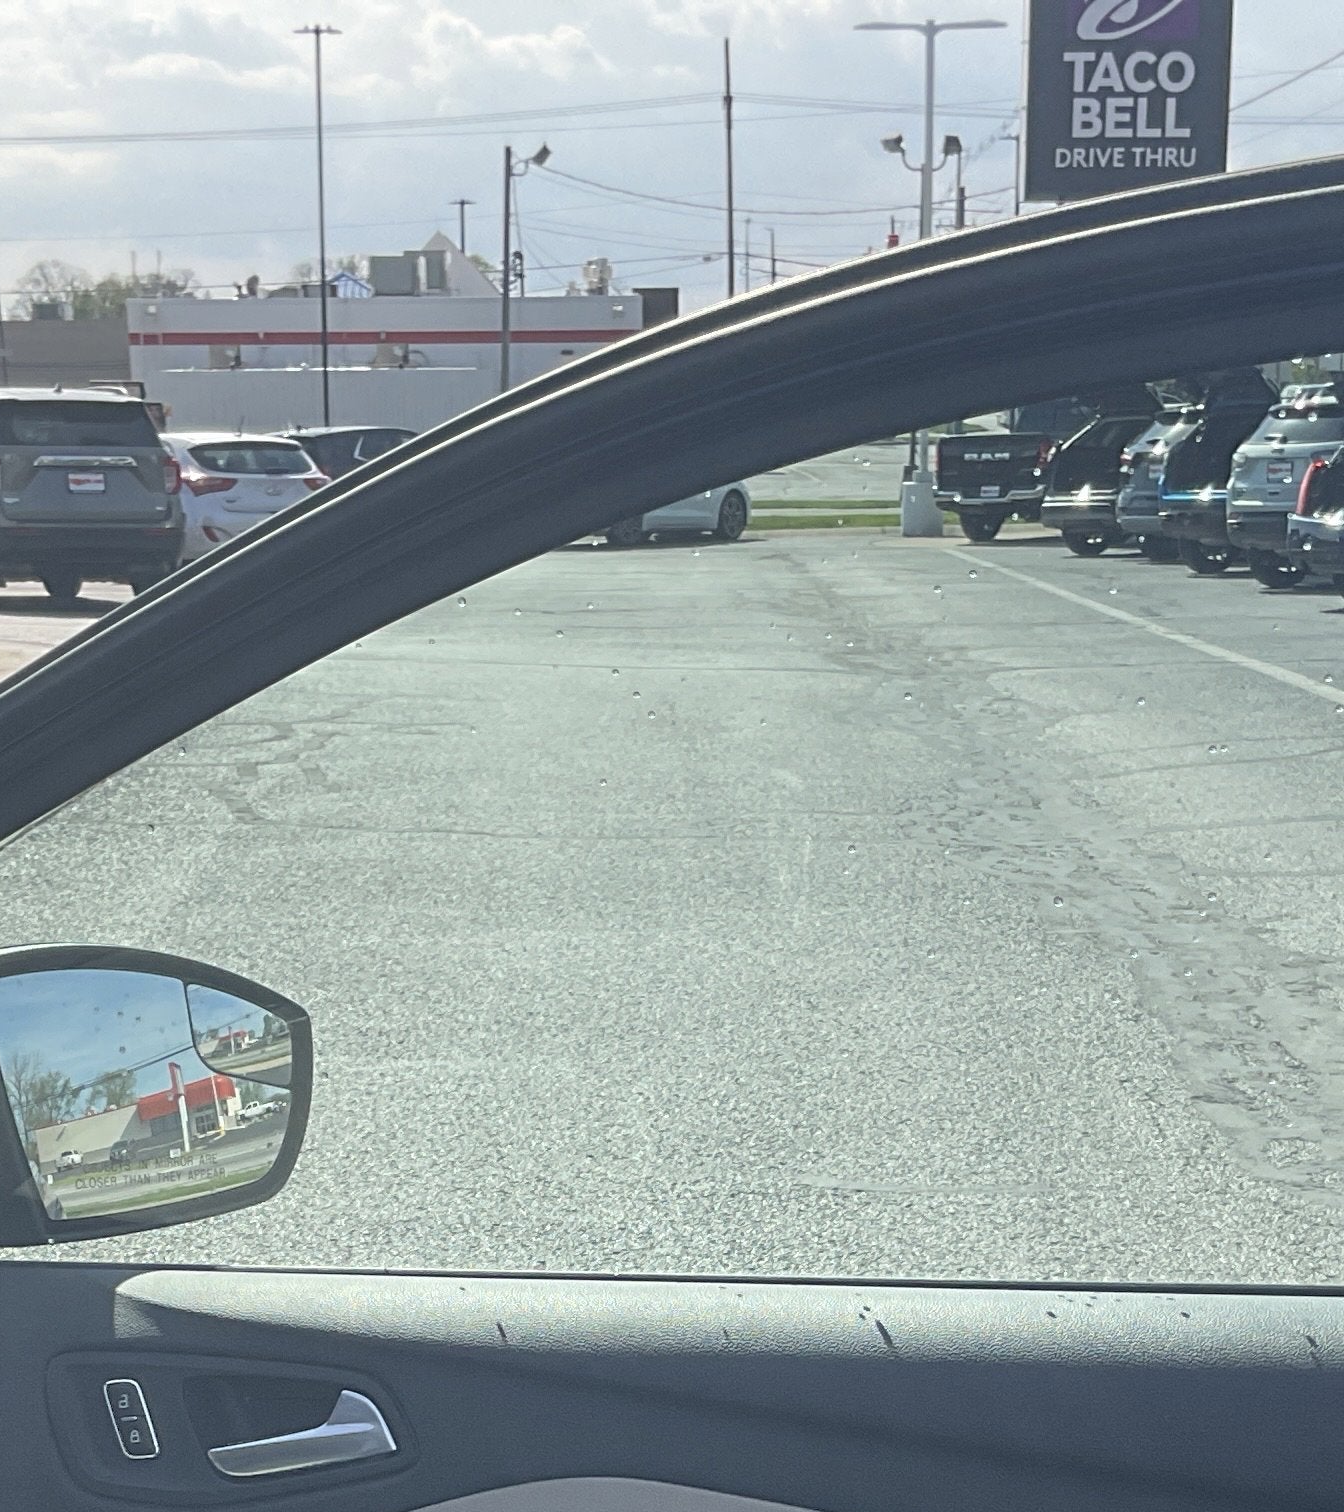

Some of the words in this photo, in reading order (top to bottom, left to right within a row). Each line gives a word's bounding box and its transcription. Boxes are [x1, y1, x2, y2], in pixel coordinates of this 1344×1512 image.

[1062, 51, 1196, 93] TACO
[1071, 97, 1191, 138] BELL
[1055, 148, 1125, 168] DRIVE
[1131, 147, 1197, 168] THRU
[199, 1153, 218, 1165] ARE
[75, 1176, 117, 1190] CLOSER
[123, 1173, 151, 1185] THAN
[157, 1171, 182, 1183] THEY
[188, 1167, 226, 1180] APPEAR
